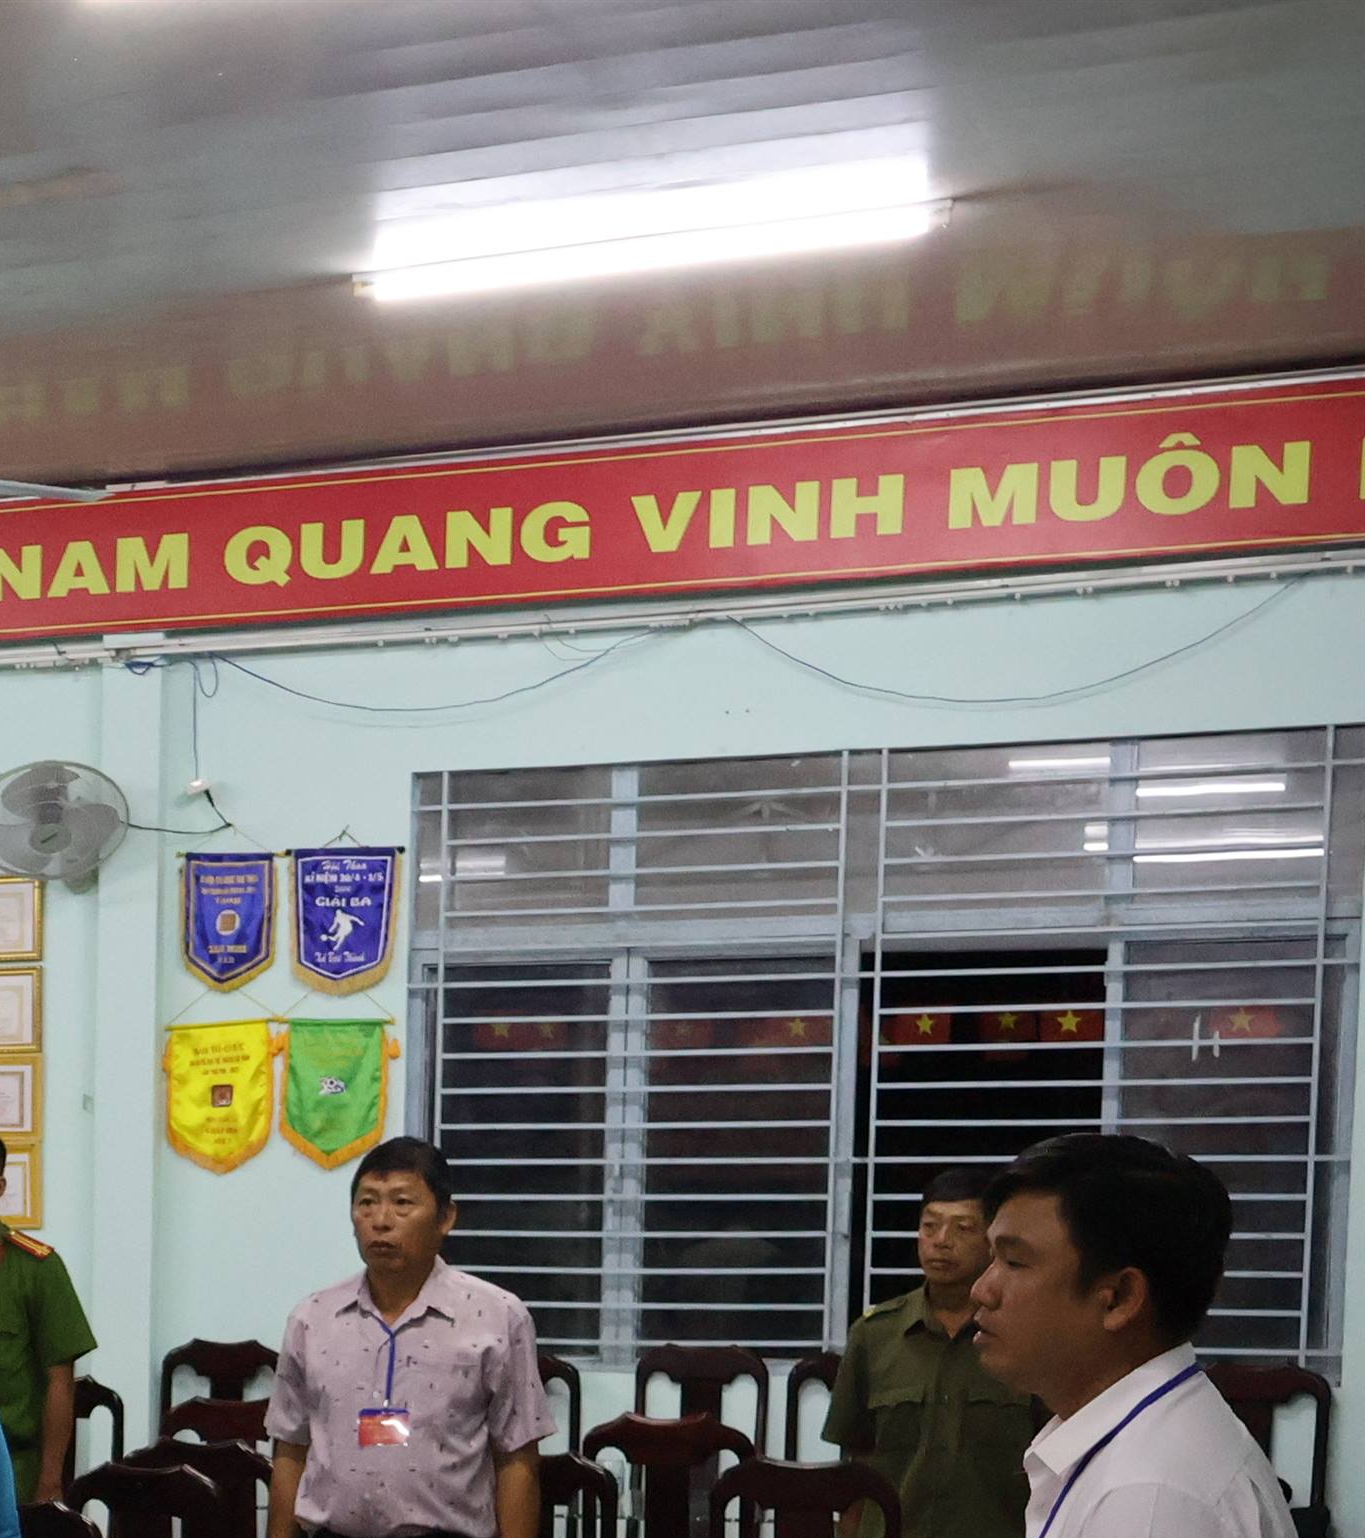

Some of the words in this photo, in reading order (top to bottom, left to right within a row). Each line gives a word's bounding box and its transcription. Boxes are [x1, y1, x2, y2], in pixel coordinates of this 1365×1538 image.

[224, 501, 591, 586] QUANG
[632, 474, 905, 553] VINH
[948, 433, 1311, 529] MUÔN
[350, 896, 372, 907] BA
